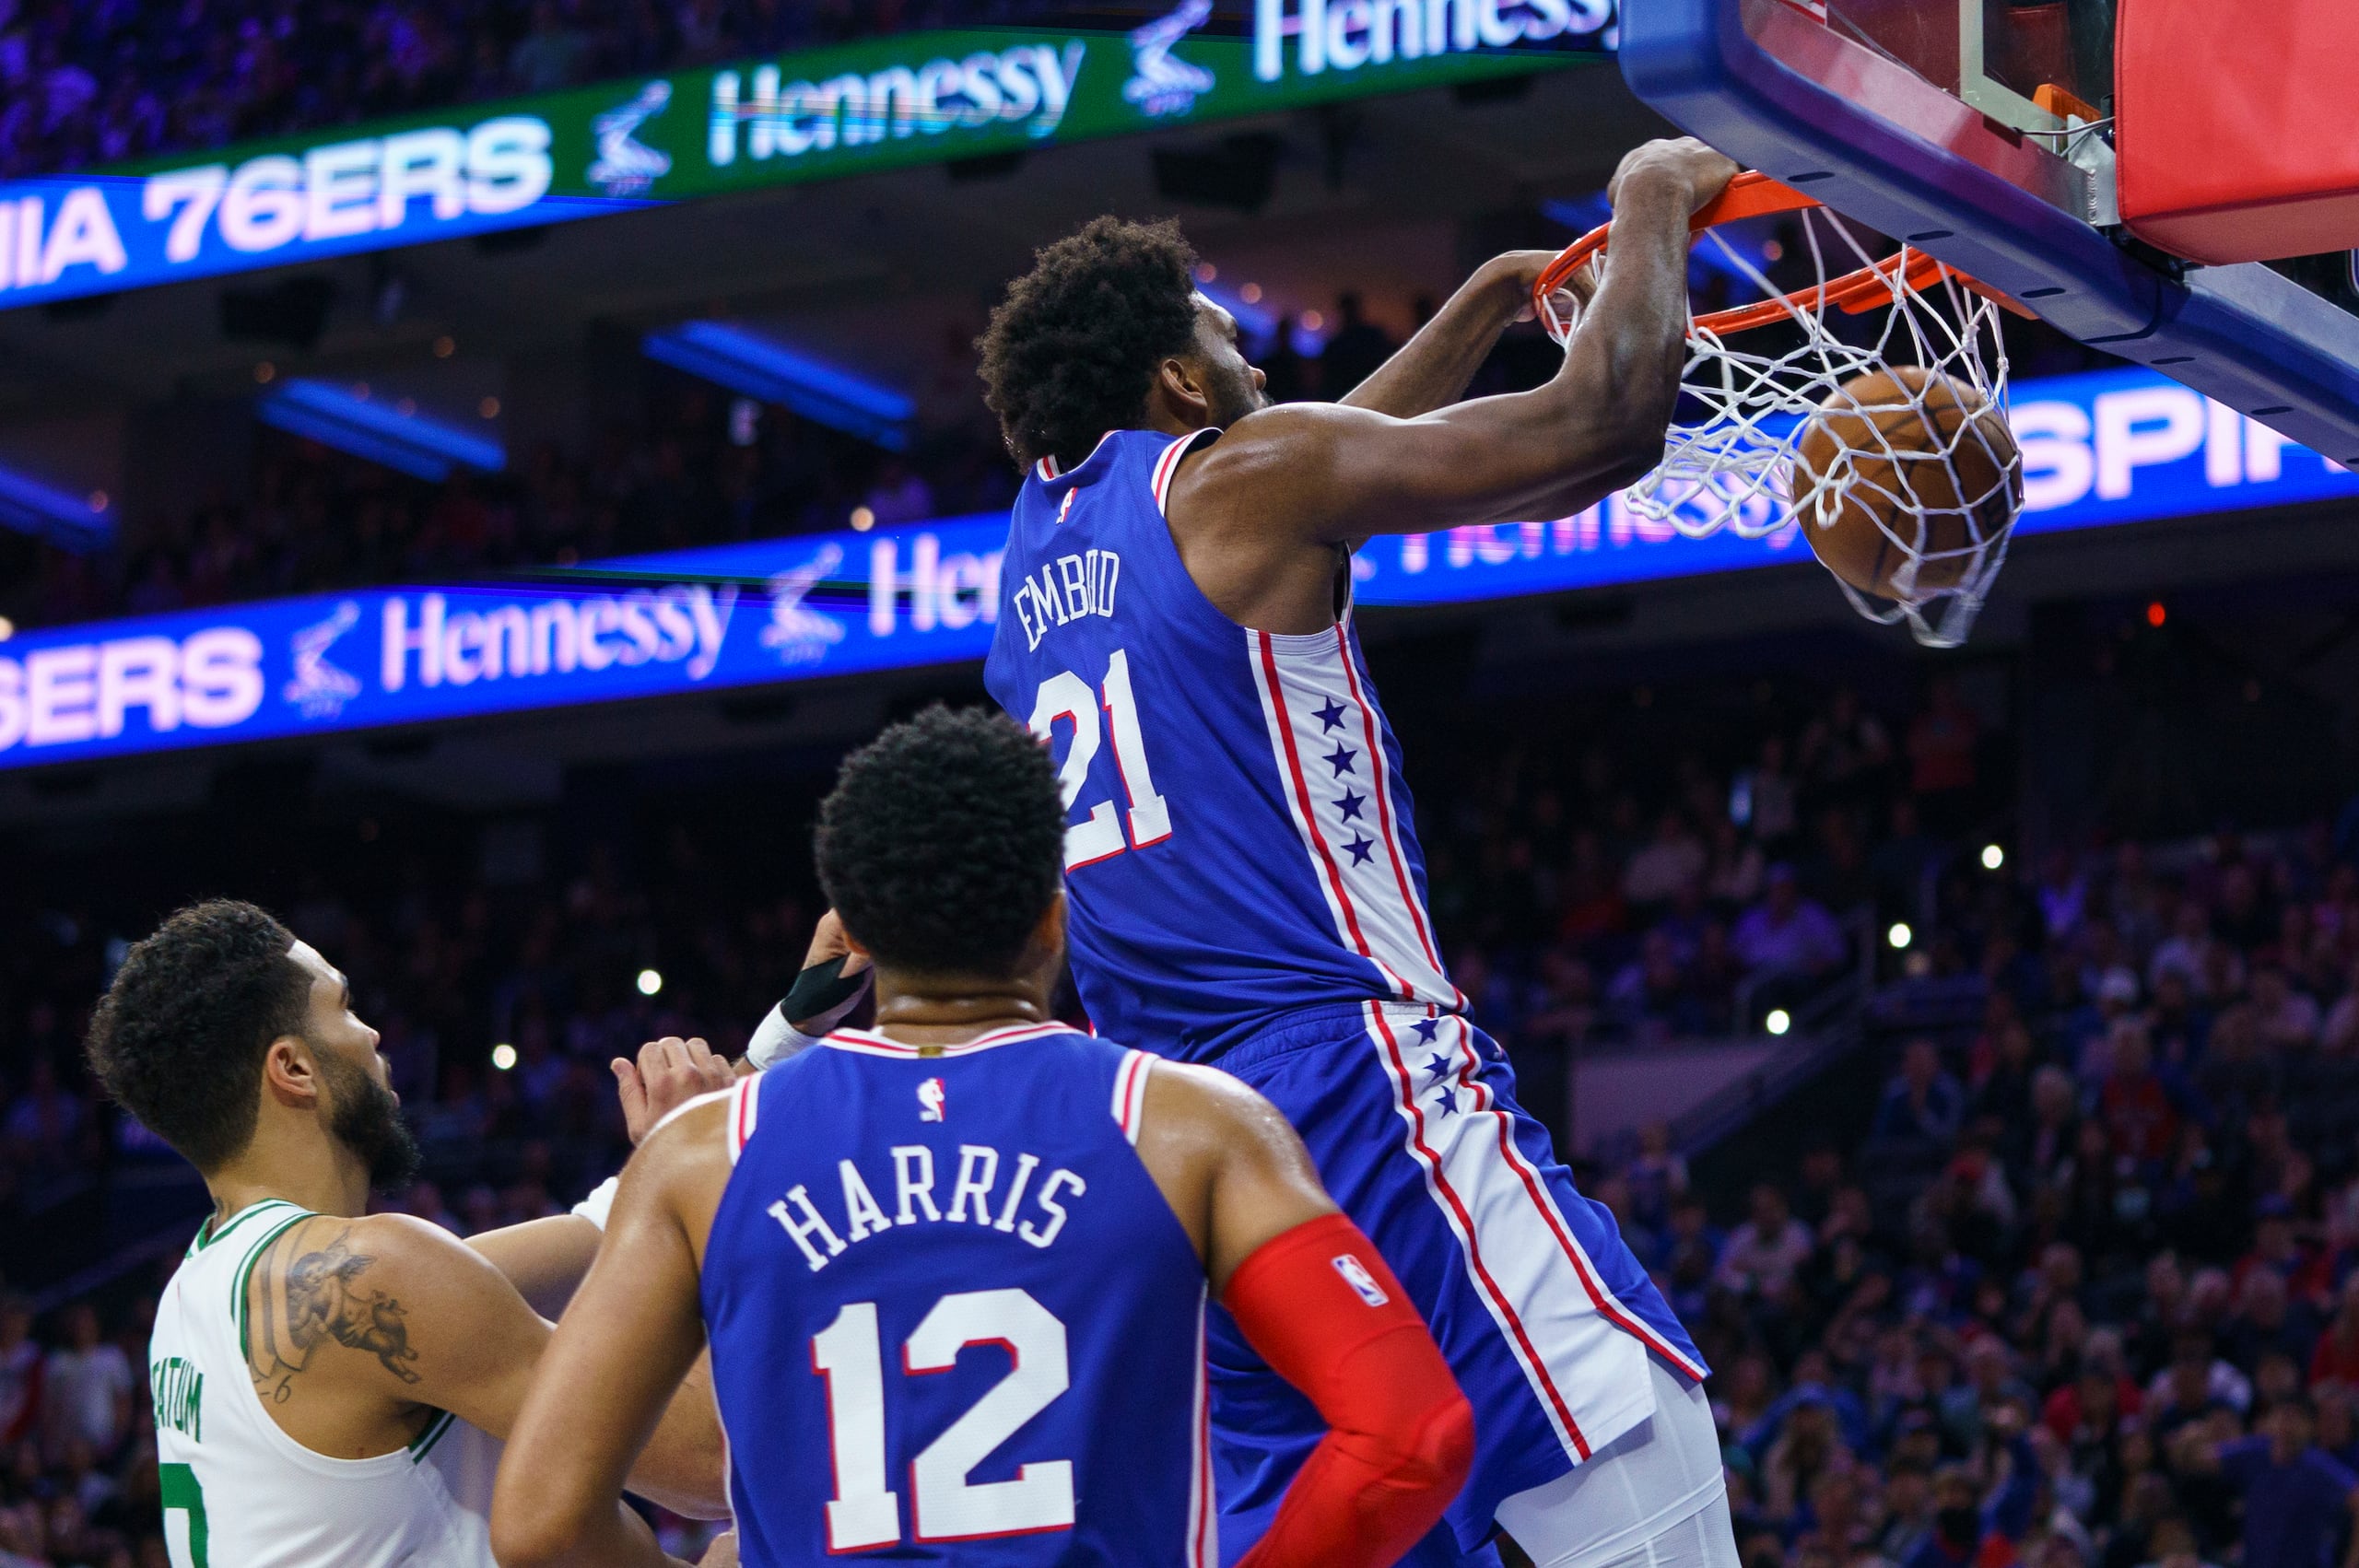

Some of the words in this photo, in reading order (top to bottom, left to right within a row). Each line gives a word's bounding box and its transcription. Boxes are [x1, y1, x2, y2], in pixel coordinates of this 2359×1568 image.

[707, 40, 1086, 167] Hennessy
[0, 186, 128, 290] IA
[142, 115, 553, 263] 76ERS
[381, 583, 739, 693] Hennessy
[1027, 649, 1173, 875] 21
[768, 1144, 1086, 1272] HARRIS
[152, 1357, 204, 1444] ATUM
[809, 1287, 1075, 1555] 12
